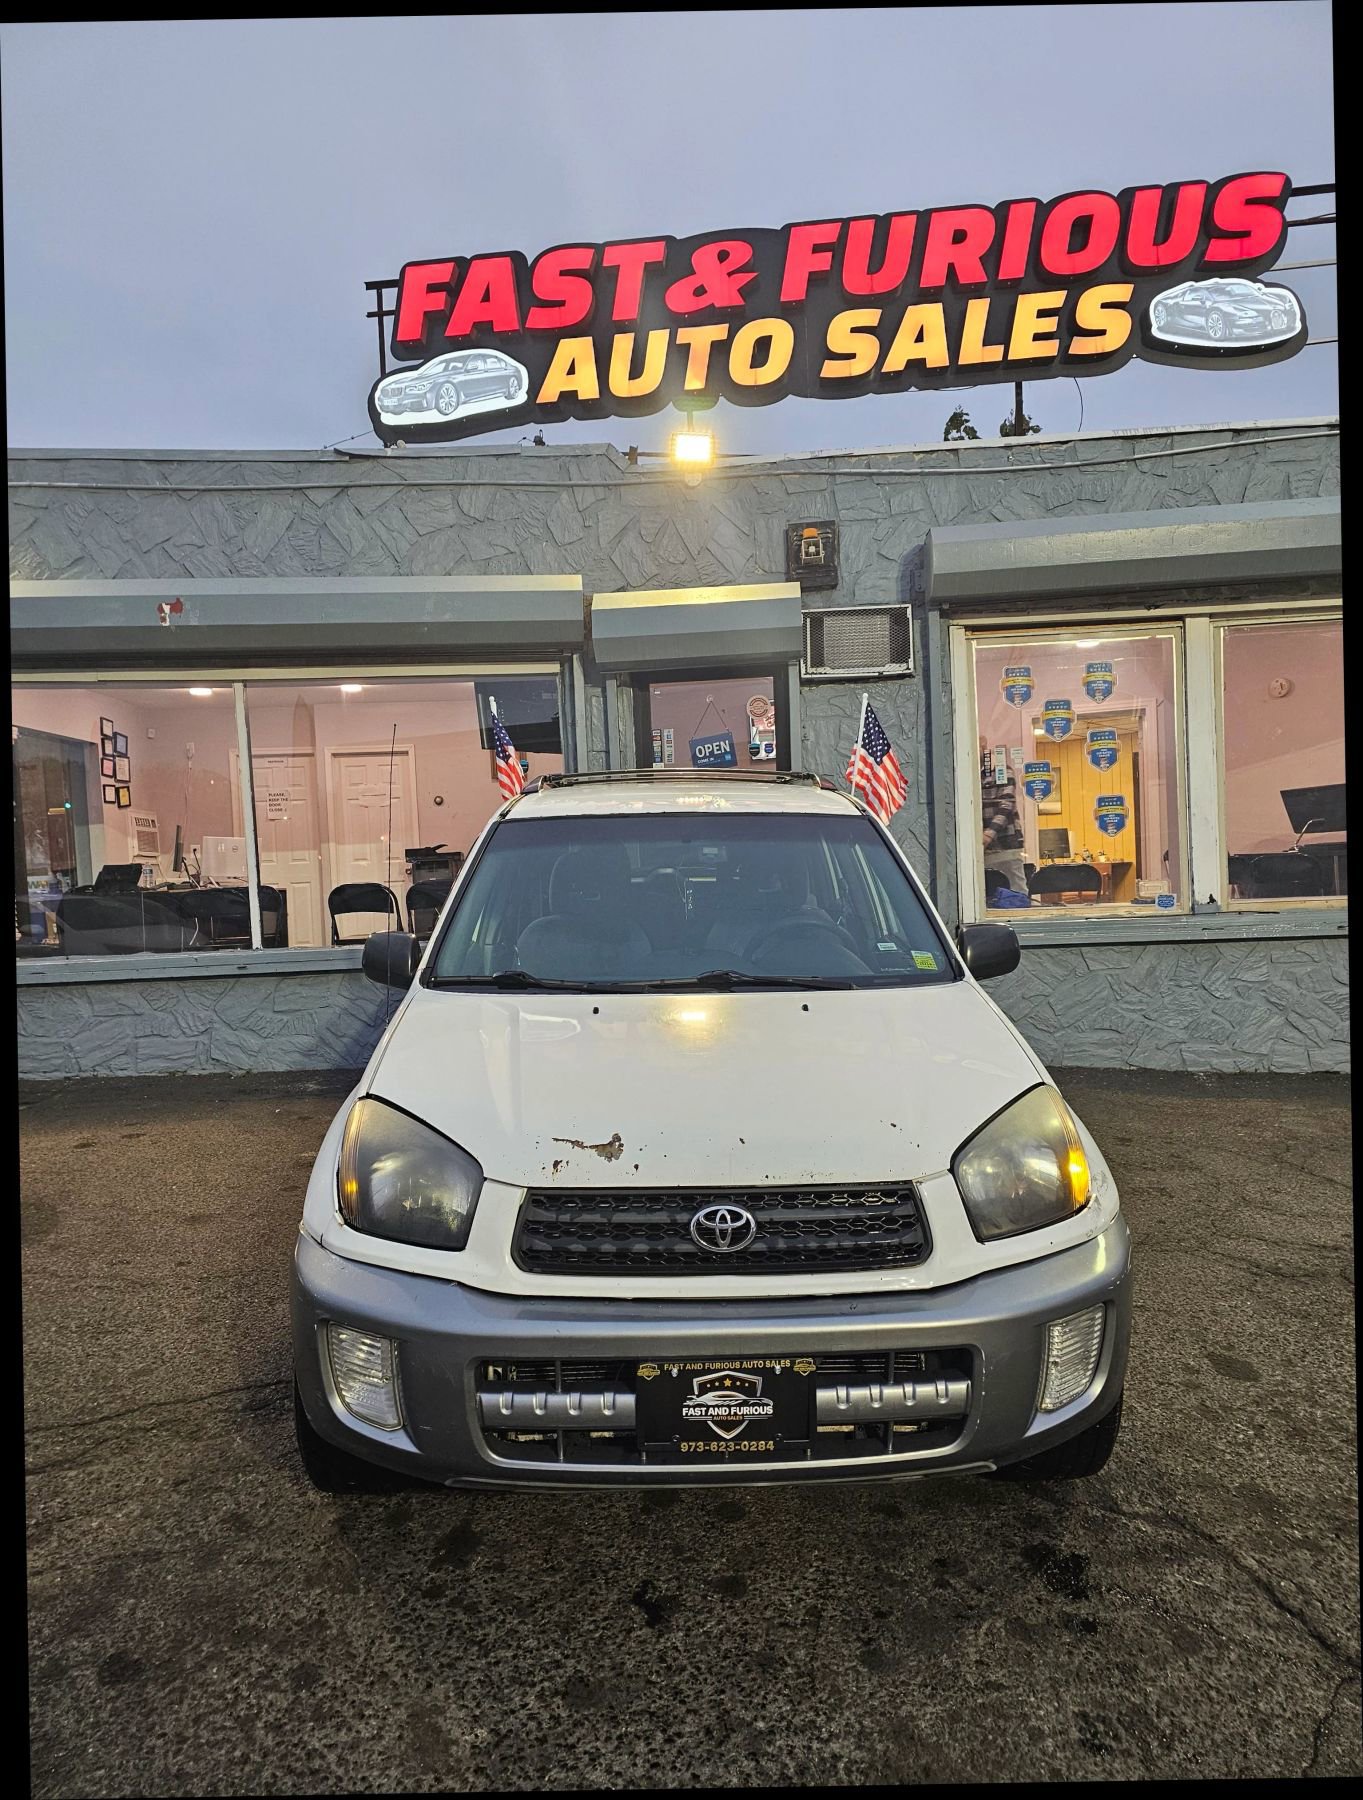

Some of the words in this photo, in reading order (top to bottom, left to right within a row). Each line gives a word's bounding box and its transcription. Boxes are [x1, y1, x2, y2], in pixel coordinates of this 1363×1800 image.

[396, 240, 667, 341] FAST
[664, 239, 760, 313] &
[780, 172, 1287, 302] FURIOUS
[535, 317, 794, 404] AUTO
[819, 282, 1135, 378] SALES
[696, 740, 730, 758] OPEN
[664, 1362, 685, 1371] FAST
[685, 1362, 703, 1371] AND
[705, 1361, 740, 1370] FURIOUS
[742, 1360, 767, 1369] AUTO
[768, 1360, 791, 1369] SALES
[682, 1406, 707, 1416] FAST
[708, 1406, 730, 1416] AND
[730, 1405, 774, 1416] FURIOUS
[680, 1440, 775, 1452] 973-623-0284
